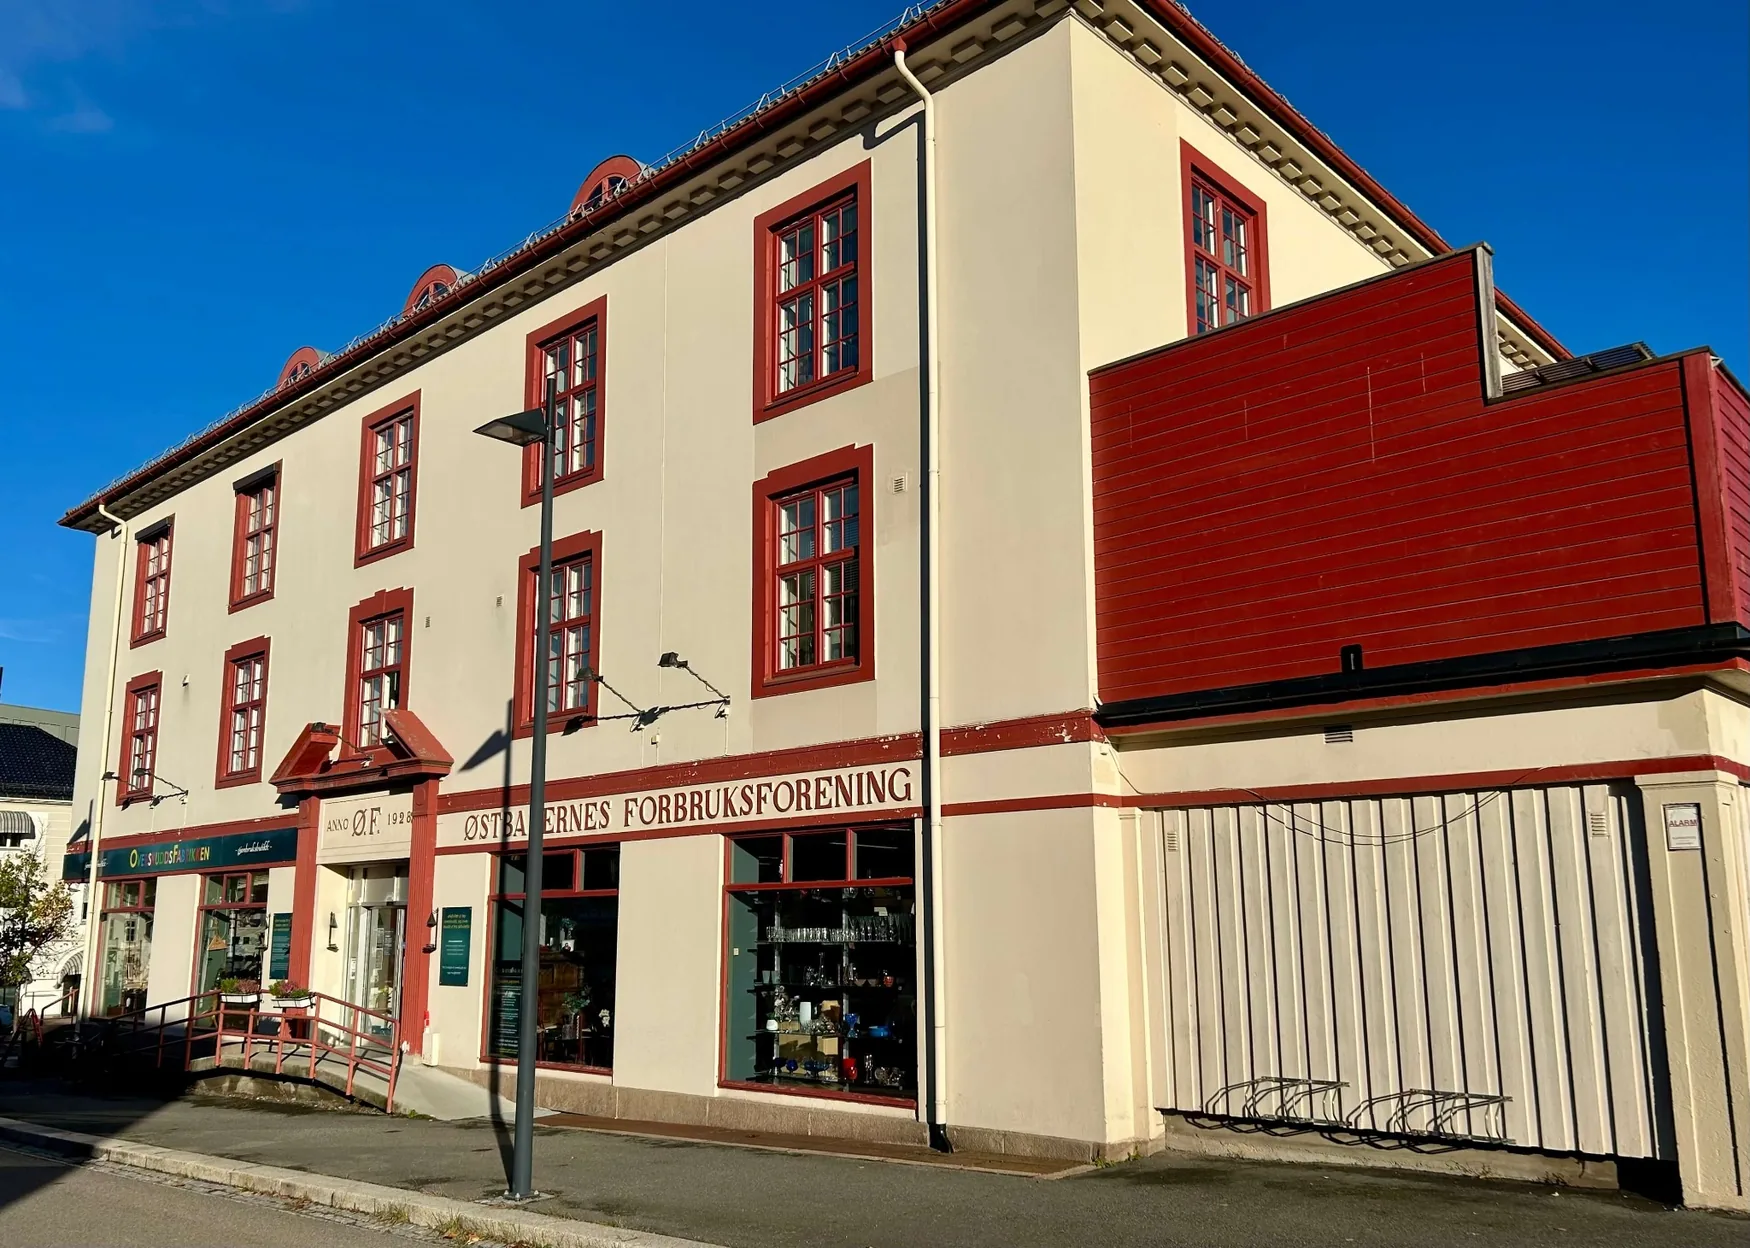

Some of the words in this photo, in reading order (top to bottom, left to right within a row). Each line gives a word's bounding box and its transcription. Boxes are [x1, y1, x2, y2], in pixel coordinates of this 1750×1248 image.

[464, 800, 611, 841] ØSTBAERNES
[623, 767, 912, 827] FORBRUKSFORENING
[327, 818, 349, 832] ANNO
[1669, 819, 1697, 828] ALARM
